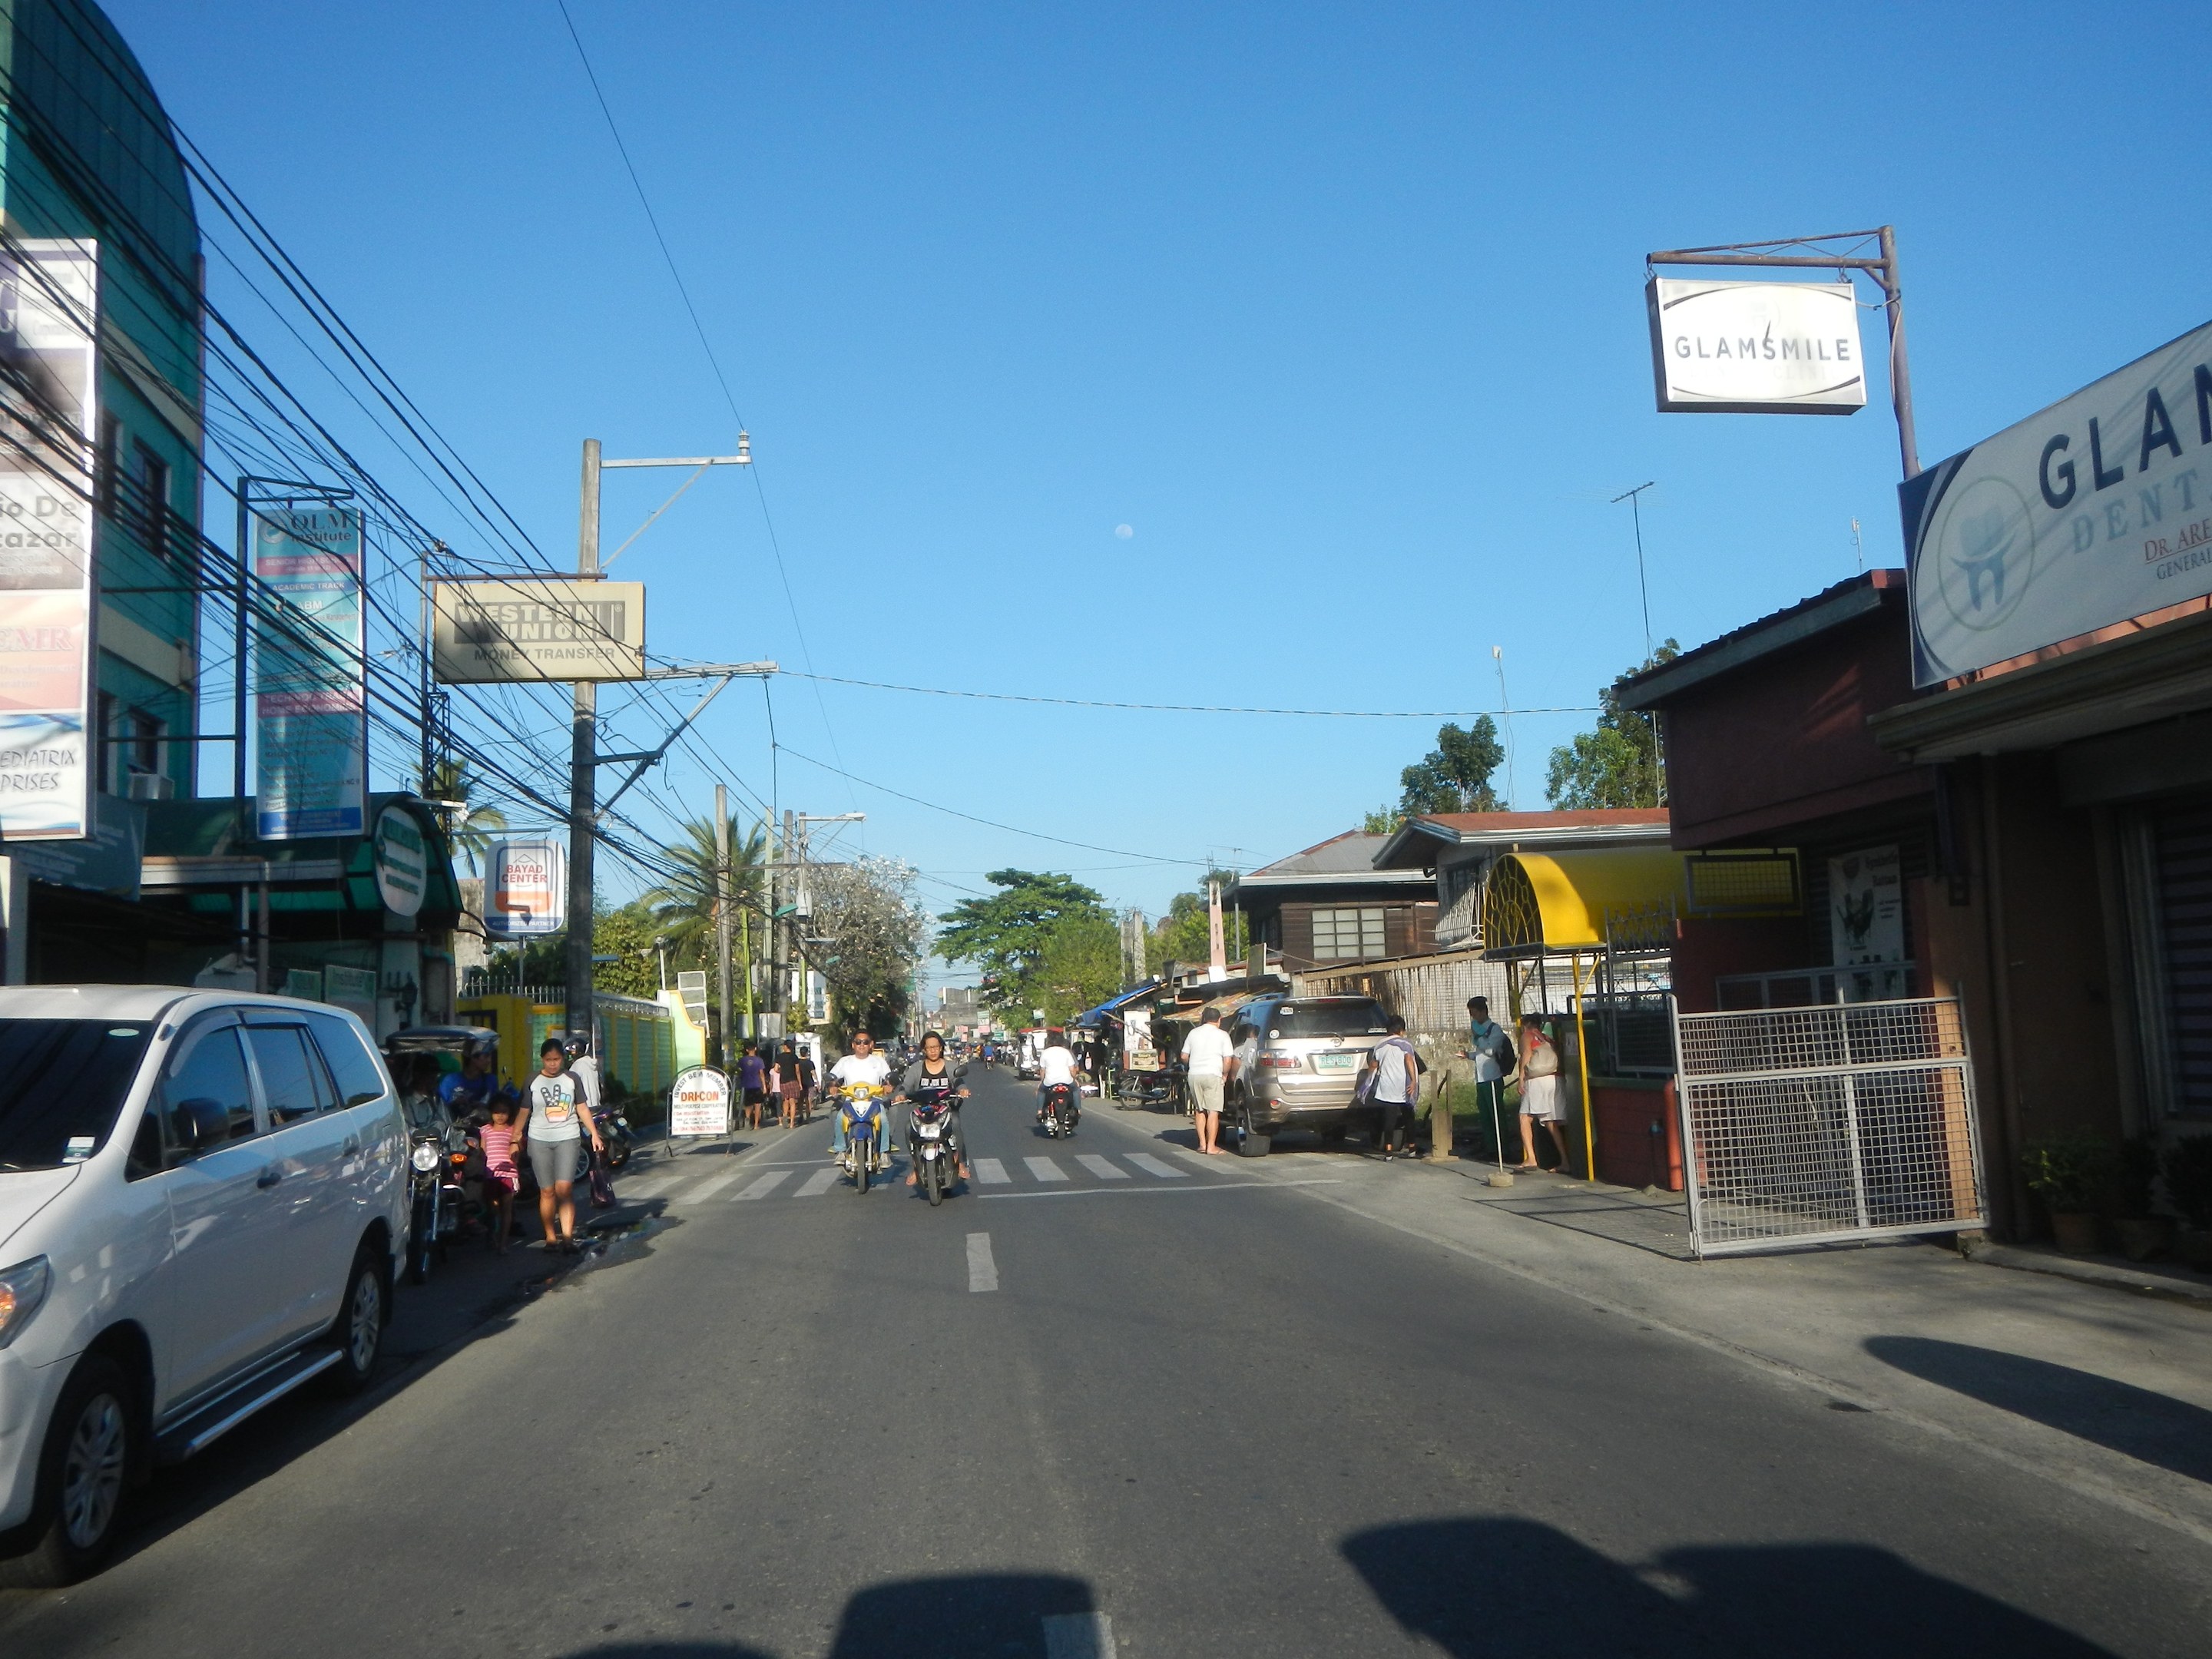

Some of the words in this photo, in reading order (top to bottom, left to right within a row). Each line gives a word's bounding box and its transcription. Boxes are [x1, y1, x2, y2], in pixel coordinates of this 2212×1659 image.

[1674, 333, 1850, 361] GLAMSMILE
[35, 495, 78, 517] De
[0, 531, 77, 548] azar
[292, 530, 352, 542] Institute
[2144, 538, 2173, 561] DR.
[273, 582, 315, 591] ACADEMIC
[317, 581, 345, 590] TRACK
[296, 600, 323, 611] ABM
[458, 604, 594, 623] WESTERN
[501, 621, 594, 641] UNION
[474, 648, 530, 661] MONEY
[535, 647, 615, 660] TRANSFER
[507, 864, 543, 873] BAYAD
[502, 874, 548, 883] CENTER
[674, 1078, 687, 1098] INVEST
[706, 1072, 727, 1096] MEMBER
